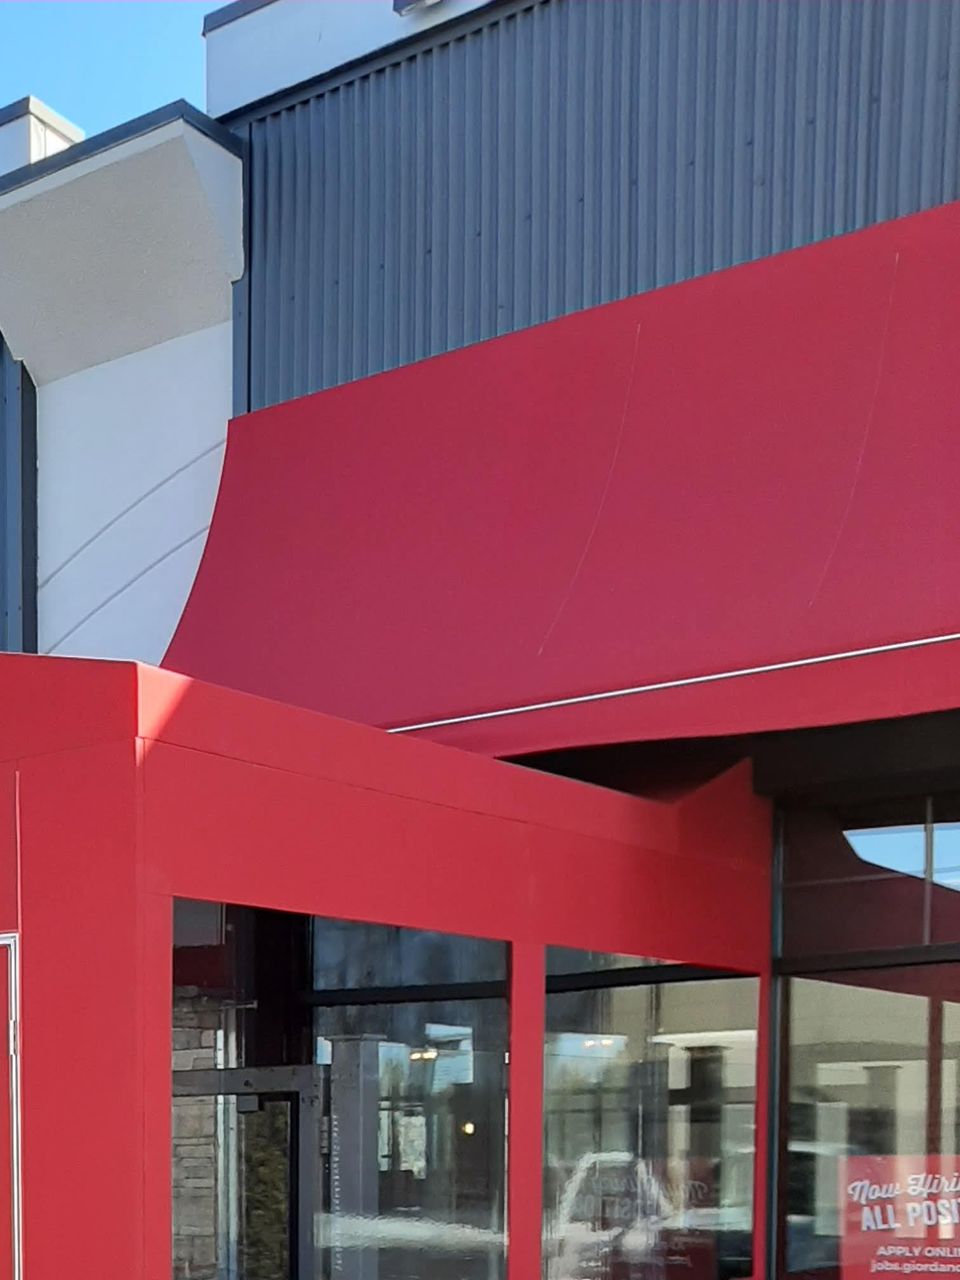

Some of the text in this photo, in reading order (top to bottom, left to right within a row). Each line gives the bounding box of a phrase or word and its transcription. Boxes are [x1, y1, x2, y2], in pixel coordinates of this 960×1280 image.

[847, 1179, 902, 1206] Now
[861, 1198, 960, 1231] ALL POSI
[876, 1245, 960, 1258] APPLY ONLI
